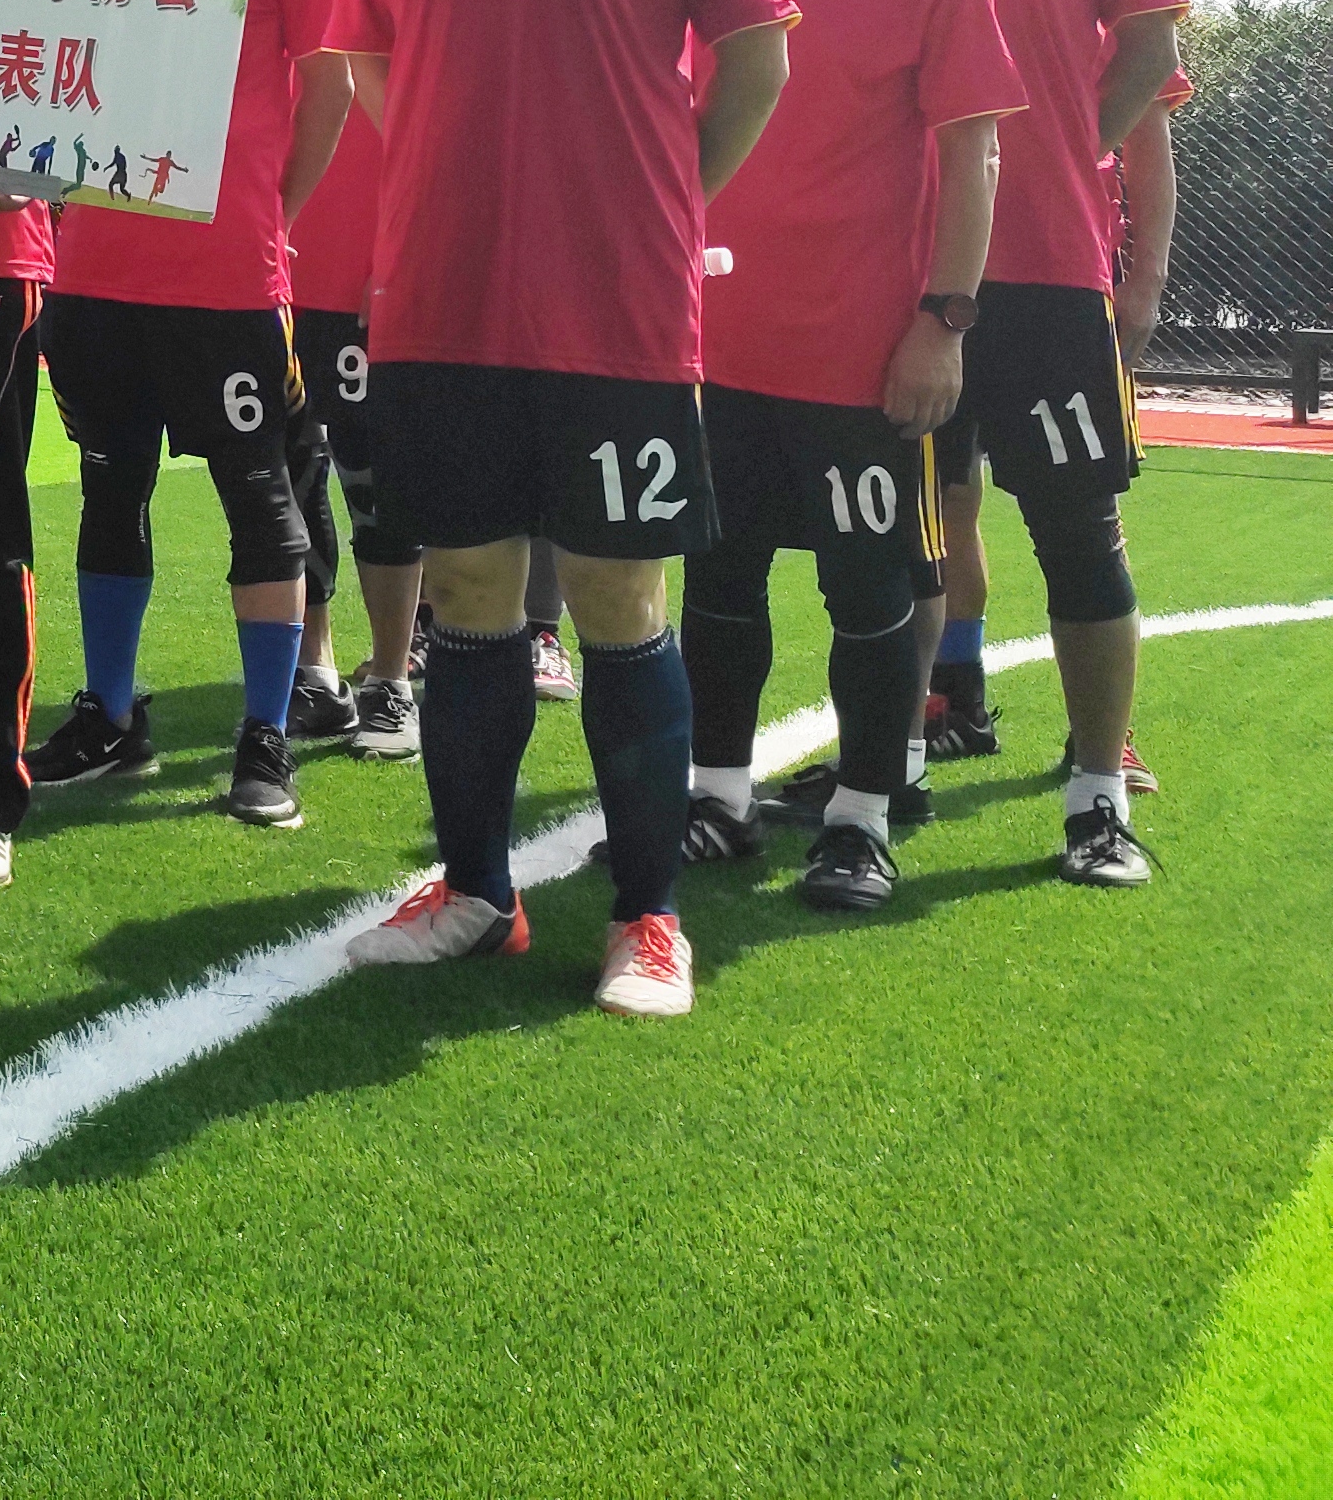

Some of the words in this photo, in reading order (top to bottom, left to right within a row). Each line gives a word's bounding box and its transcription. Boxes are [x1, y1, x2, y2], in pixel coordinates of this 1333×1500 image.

[223, 371, 264, 432] 6
[336, 344, 369, 403] 9
[1029, 390, 1106, 465] 11
[589, 437, 688, 523] 12
[824, 464, 897, 535] 10
